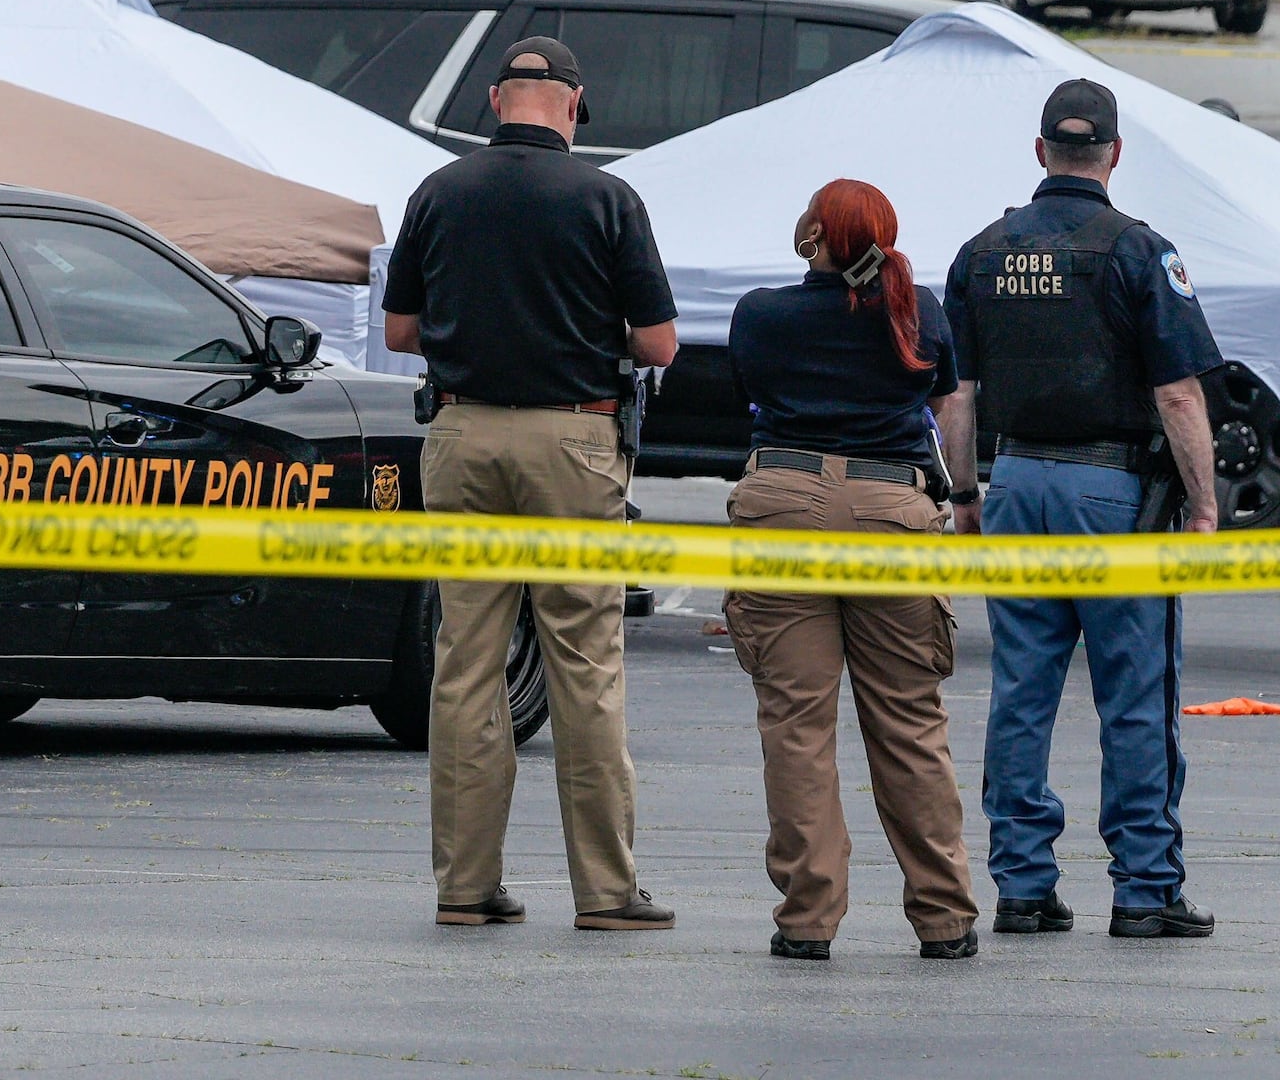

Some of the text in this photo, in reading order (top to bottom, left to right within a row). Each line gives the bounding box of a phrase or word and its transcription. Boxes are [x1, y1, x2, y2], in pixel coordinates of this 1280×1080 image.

[1004, 254, 1054, 273] COBB
[996, 275, 1064, 295] POLICE
[43, 453, 197, 510] COUNTY
[202, 460, 334, 513] POLICE
